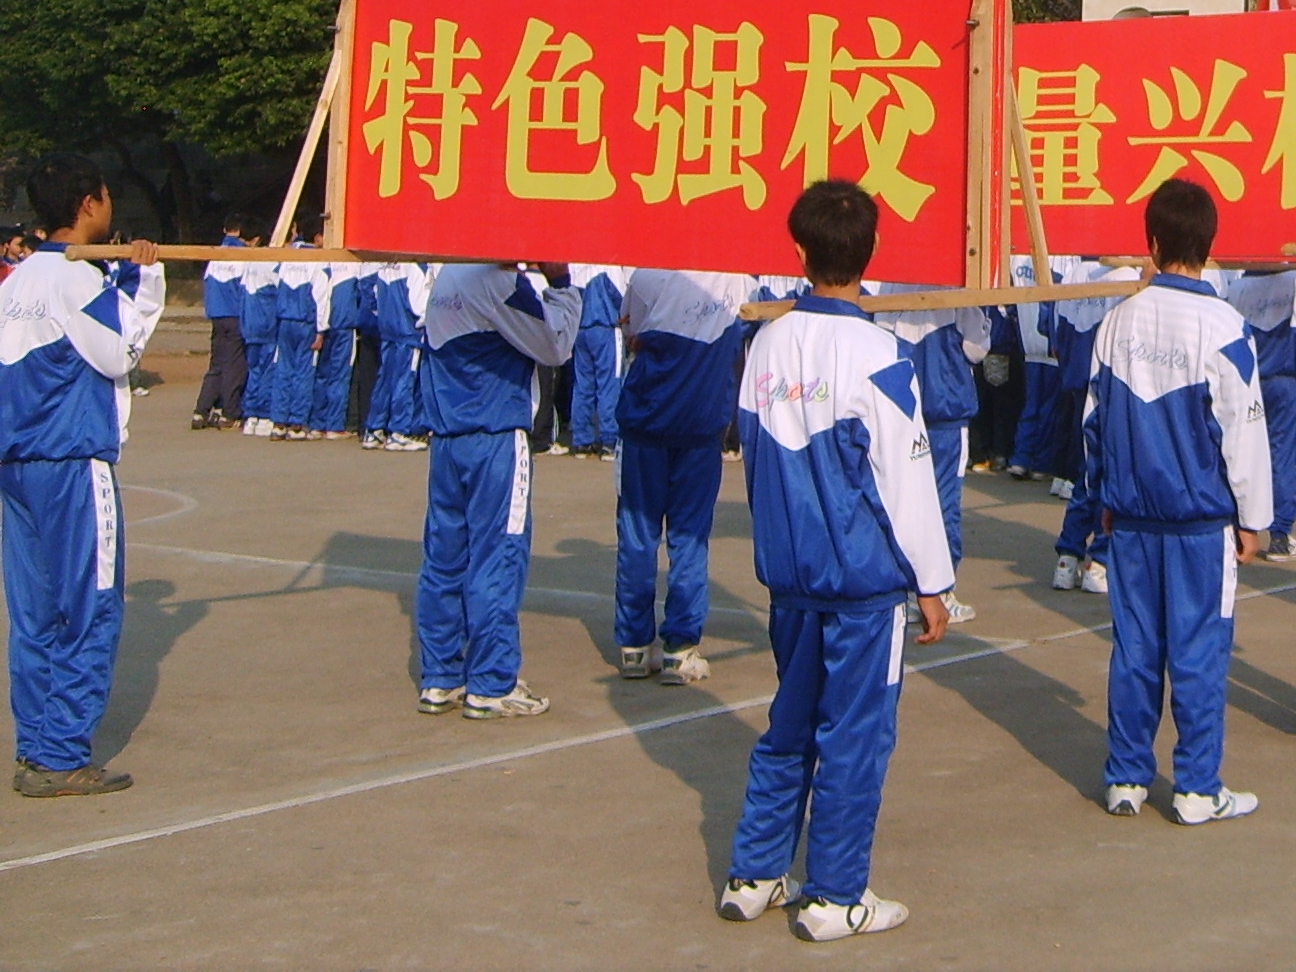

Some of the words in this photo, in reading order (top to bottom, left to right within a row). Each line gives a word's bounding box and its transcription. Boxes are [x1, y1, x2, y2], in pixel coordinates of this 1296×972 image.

[362, 13, 942, 222] 特色强校
[1114, 335, 1189, 370] Sports
[99, 471, 115, 549] SPORT
